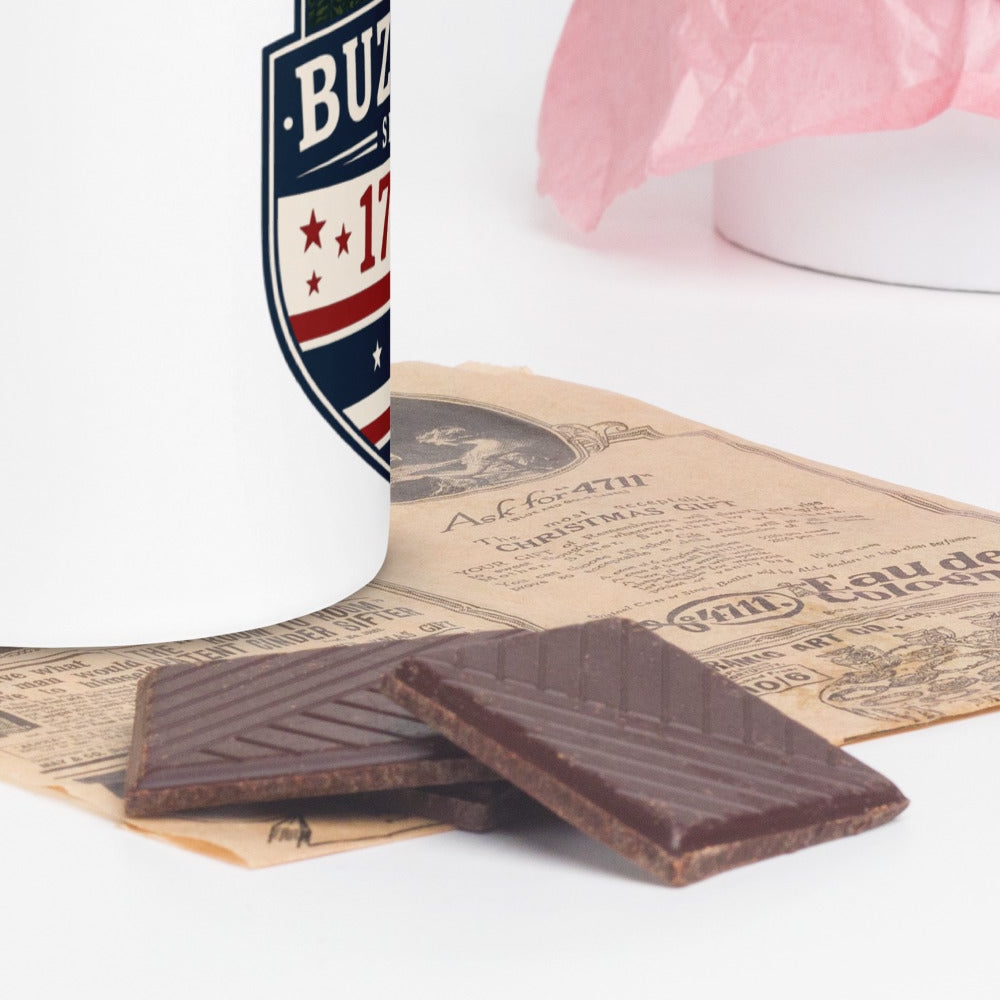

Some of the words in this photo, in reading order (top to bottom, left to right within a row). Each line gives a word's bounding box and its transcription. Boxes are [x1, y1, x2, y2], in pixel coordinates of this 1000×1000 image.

[441, 498, 517, 533] Ask
[522, 489, 568, 508] for
[495, 507, 665, 552] CHRISTMAS
[673, 500, 738, 511] GIFT
[473, 535, 521, 546] The
[544, 510, 590, 528] most
[454, 560, 509, 576] YOUR
[514, 549, 554, 561] GIFT
[800, 560, 936, 593] Eau
[938, 550, 1000, 571] de
[246, 625, 338, 651] CINDER
[333, 606, 424, 632] SIFTER
[418, 620, 458, 633] GIFT
[122, 644, 186, 659] THE
[790, 632, 846, 652] ART
[15, 675, 66, 690] man
[70, 657, 145, 680] would
[30, 658, 94, 677] what
[37, 686, 68, 696] to
